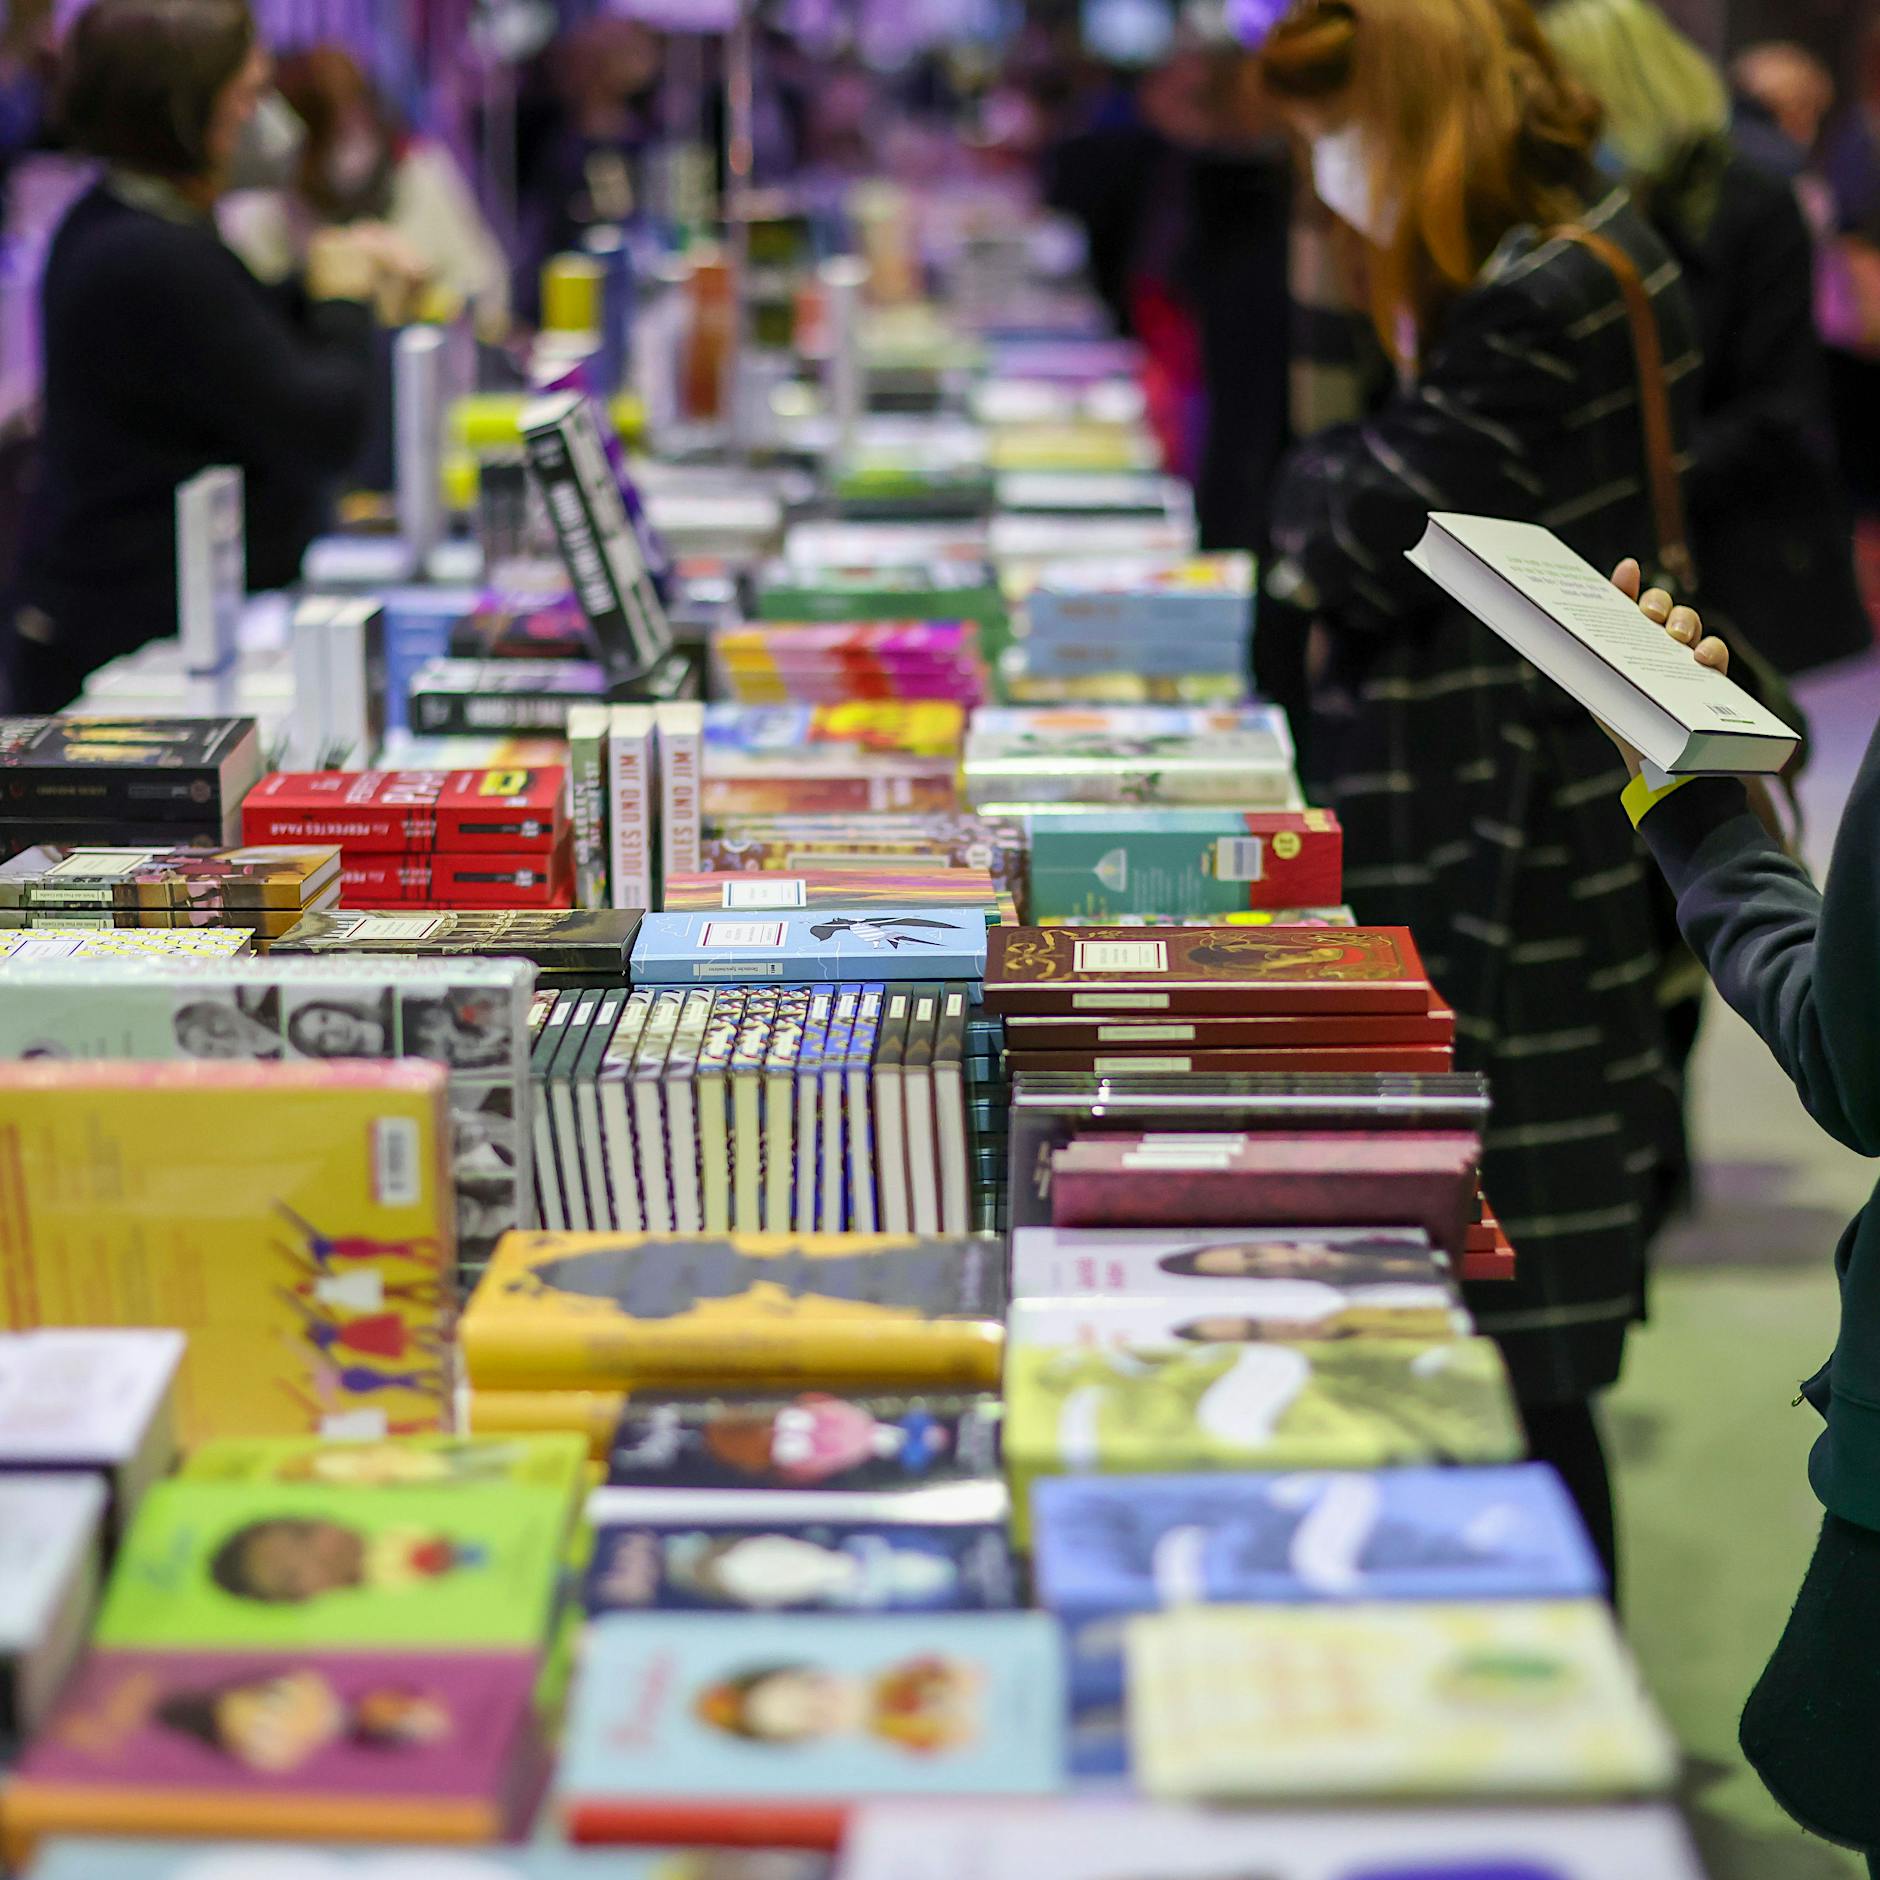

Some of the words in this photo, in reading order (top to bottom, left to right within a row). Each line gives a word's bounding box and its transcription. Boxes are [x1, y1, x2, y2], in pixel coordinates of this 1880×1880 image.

[619, 754, 640, 781] JIM
[671, 751, 693, 778] JIM
[620, 789, 641, 823] UND
[672, 786, 693, 820] UND
[620, 829, 642, 878] JULES
[672, 826, 694, 874] JULES
